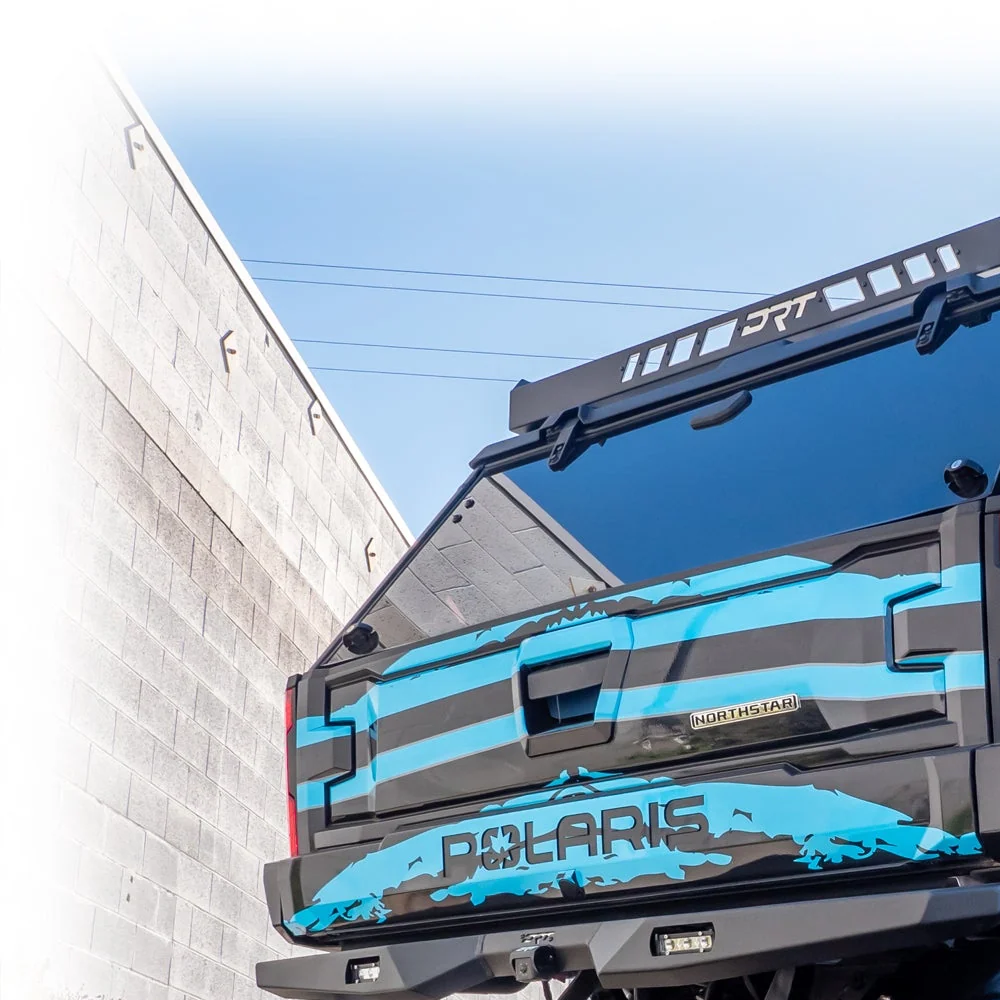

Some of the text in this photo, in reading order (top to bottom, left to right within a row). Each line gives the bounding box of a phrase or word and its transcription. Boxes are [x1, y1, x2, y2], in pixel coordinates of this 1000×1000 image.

[741, 291, 818, 337] DRT
[694, 697, 794, 726] NORTHSTAR
[442, 795, 710, 877] POLARIS
